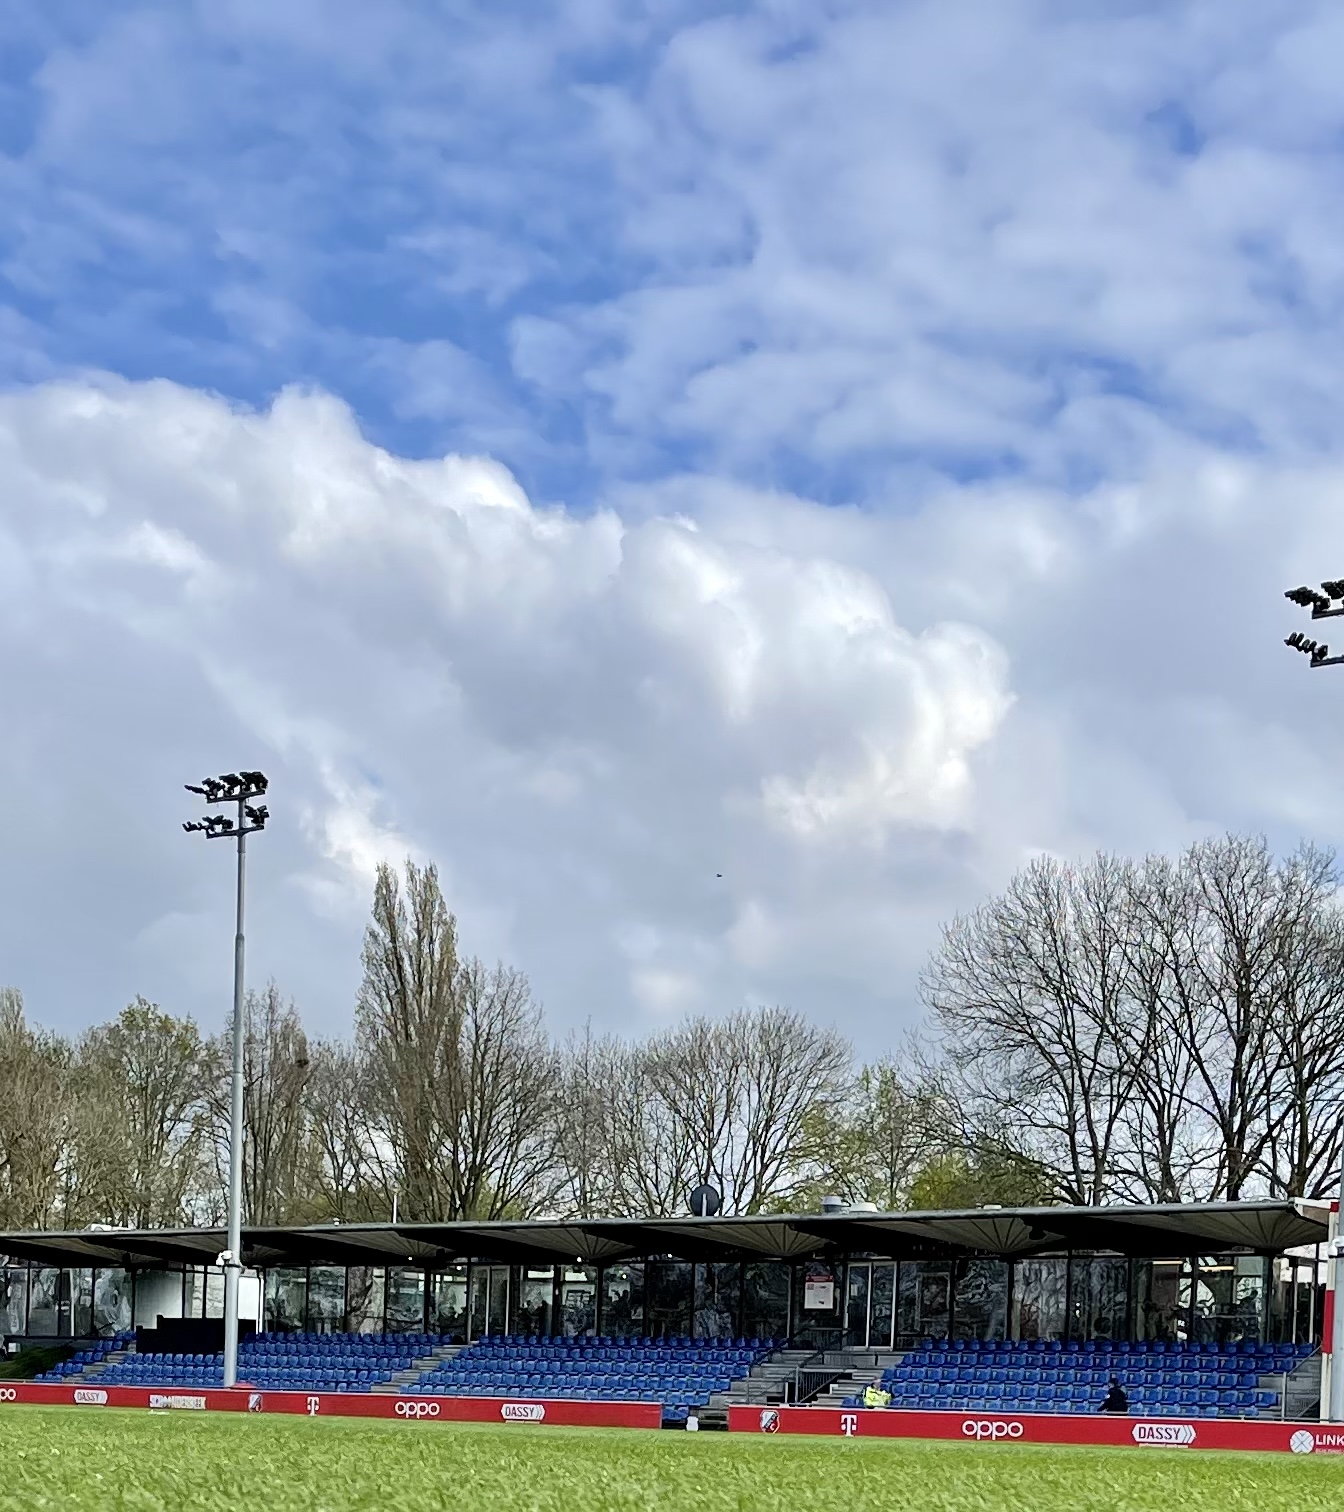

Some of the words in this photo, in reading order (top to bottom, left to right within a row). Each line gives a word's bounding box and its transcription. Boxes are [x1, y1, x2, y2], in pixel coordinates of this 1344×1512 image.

[394, 1401, 440, 1419] oppo
[505, 1405, 535, 1418] DASSY
[961, 1420, 1024, 1440] oppo
[1138, 1426, 1182, 1441] DASSY
